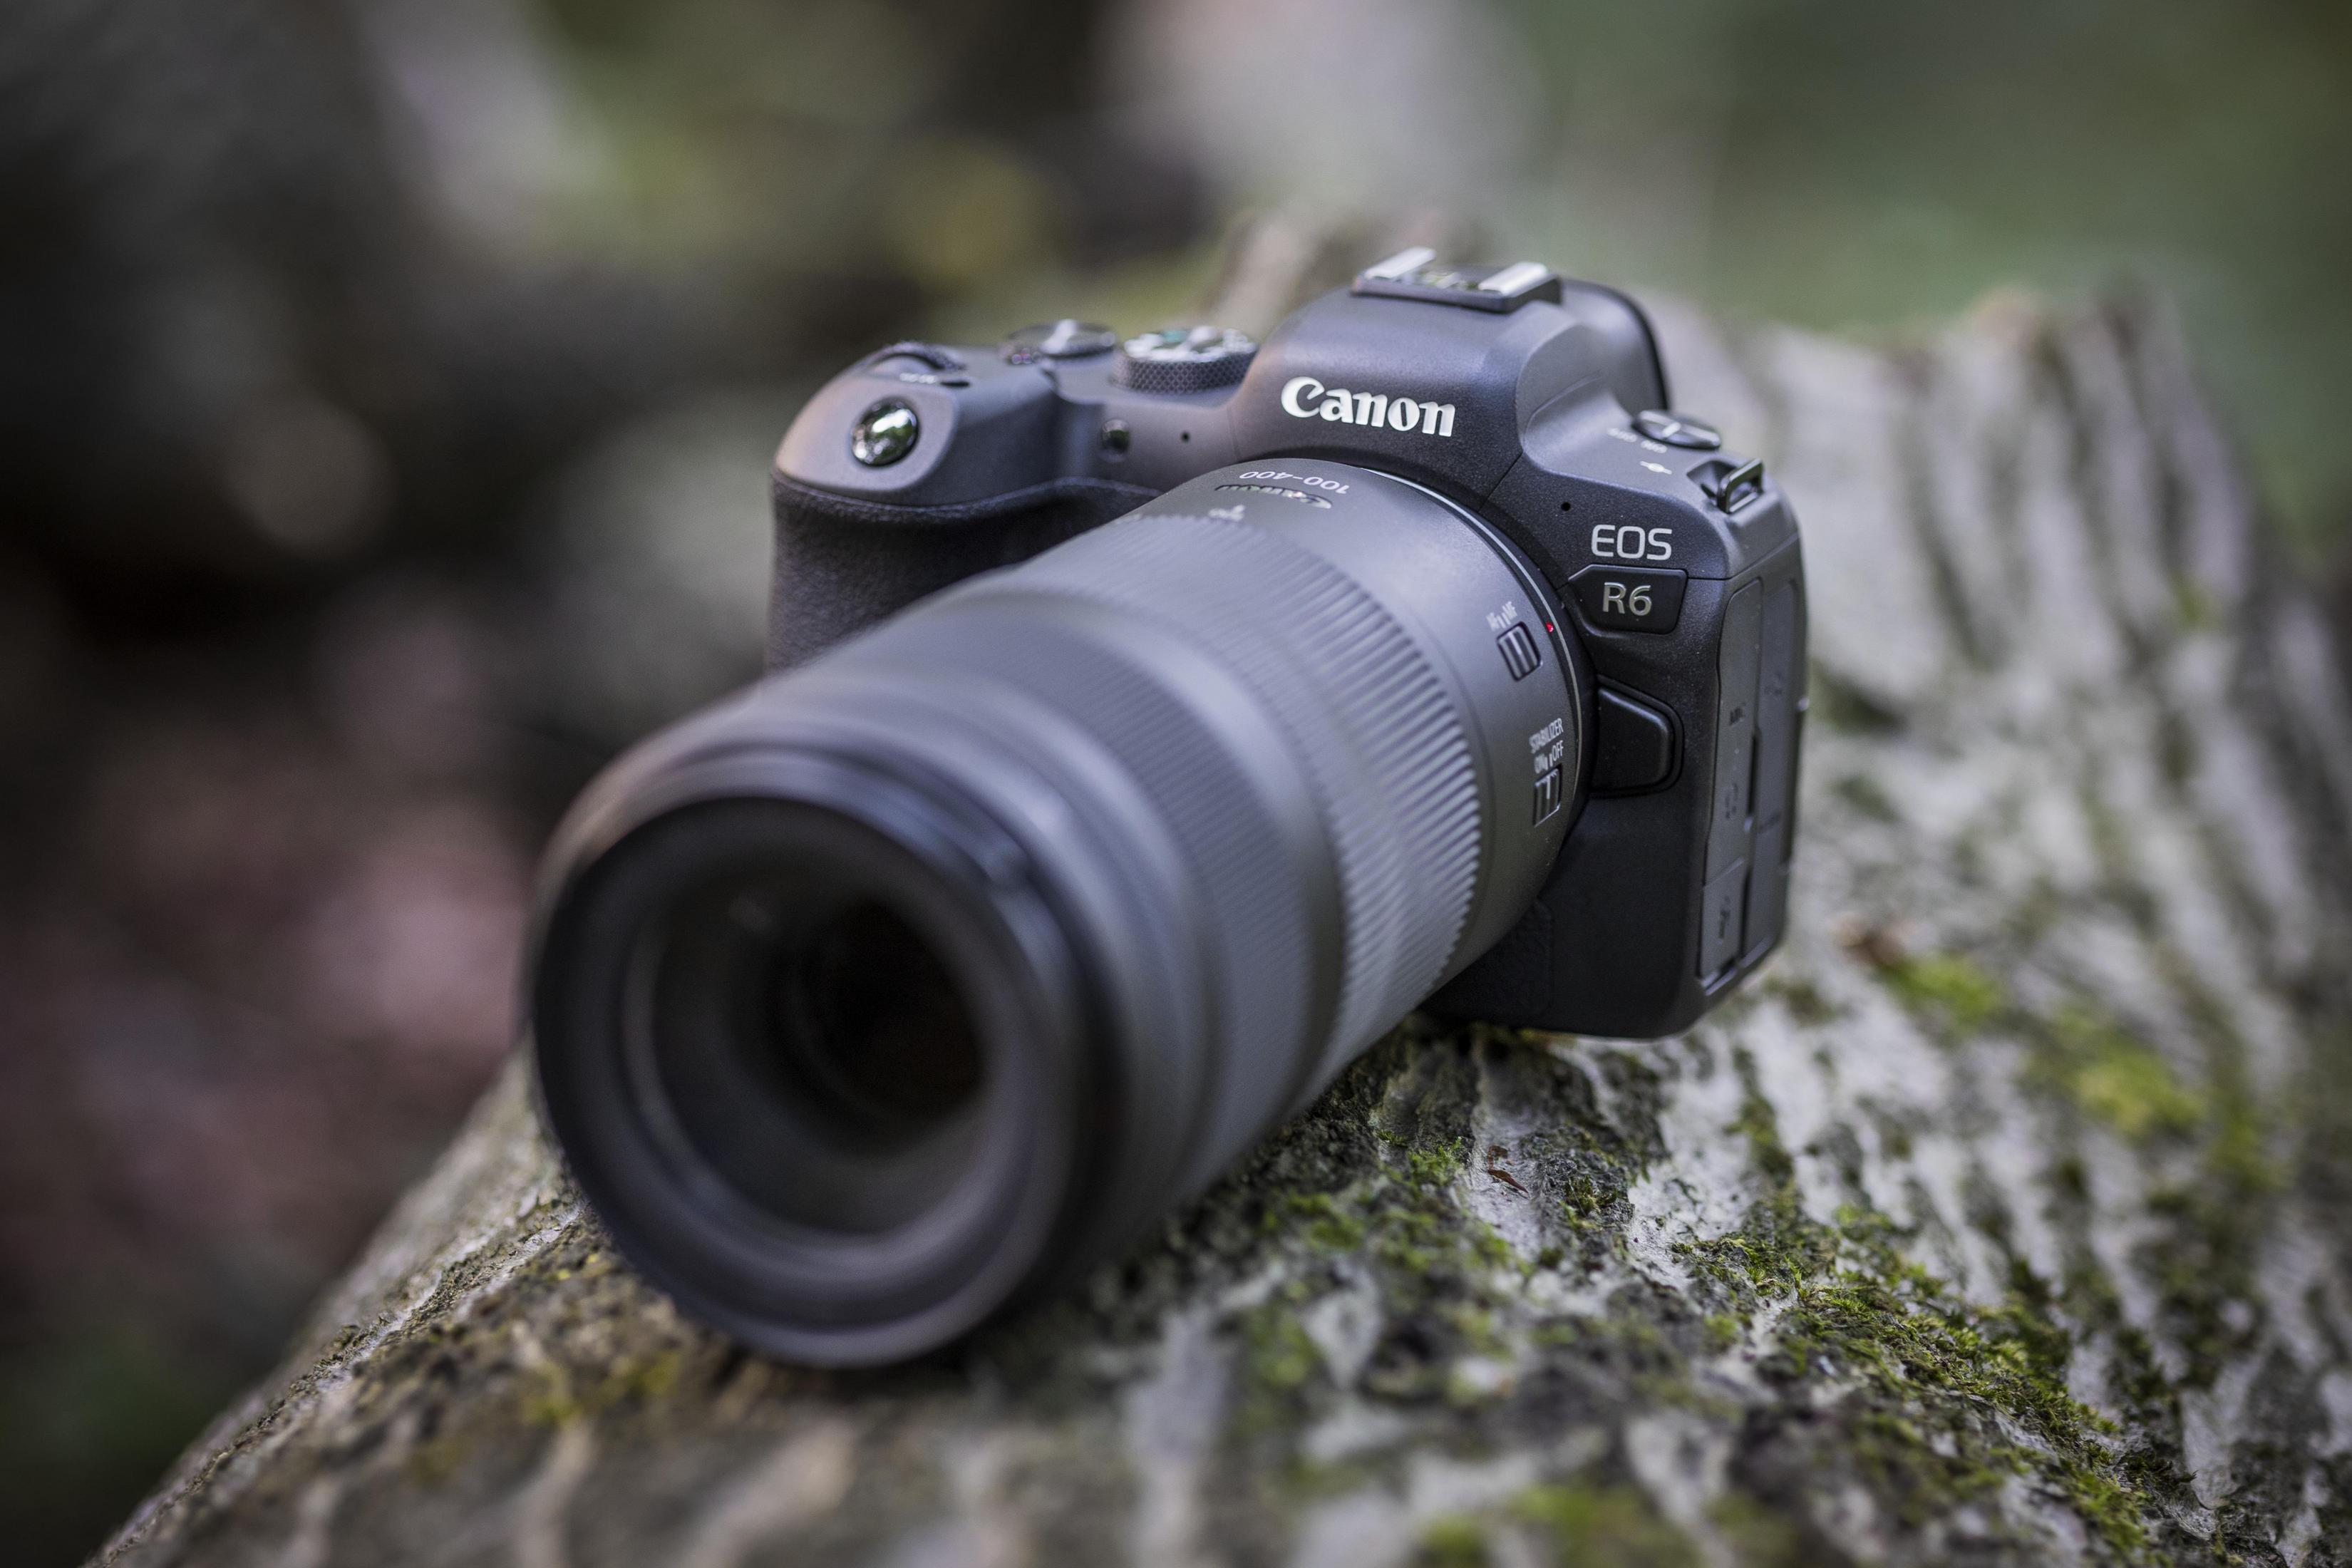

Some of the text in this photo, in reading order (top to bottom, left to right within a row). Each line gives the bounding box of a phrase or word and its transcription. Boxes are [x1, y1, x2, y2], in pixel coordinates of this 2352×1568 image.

[1281, 376, 1455, 437] Canon
[1239, 471, 1350, 494] 100-400
[1591, 524, 1673, 560] EOS
[1602, 582, 1652, 616] R6
[1552, 740, 1564, 761] OFF
